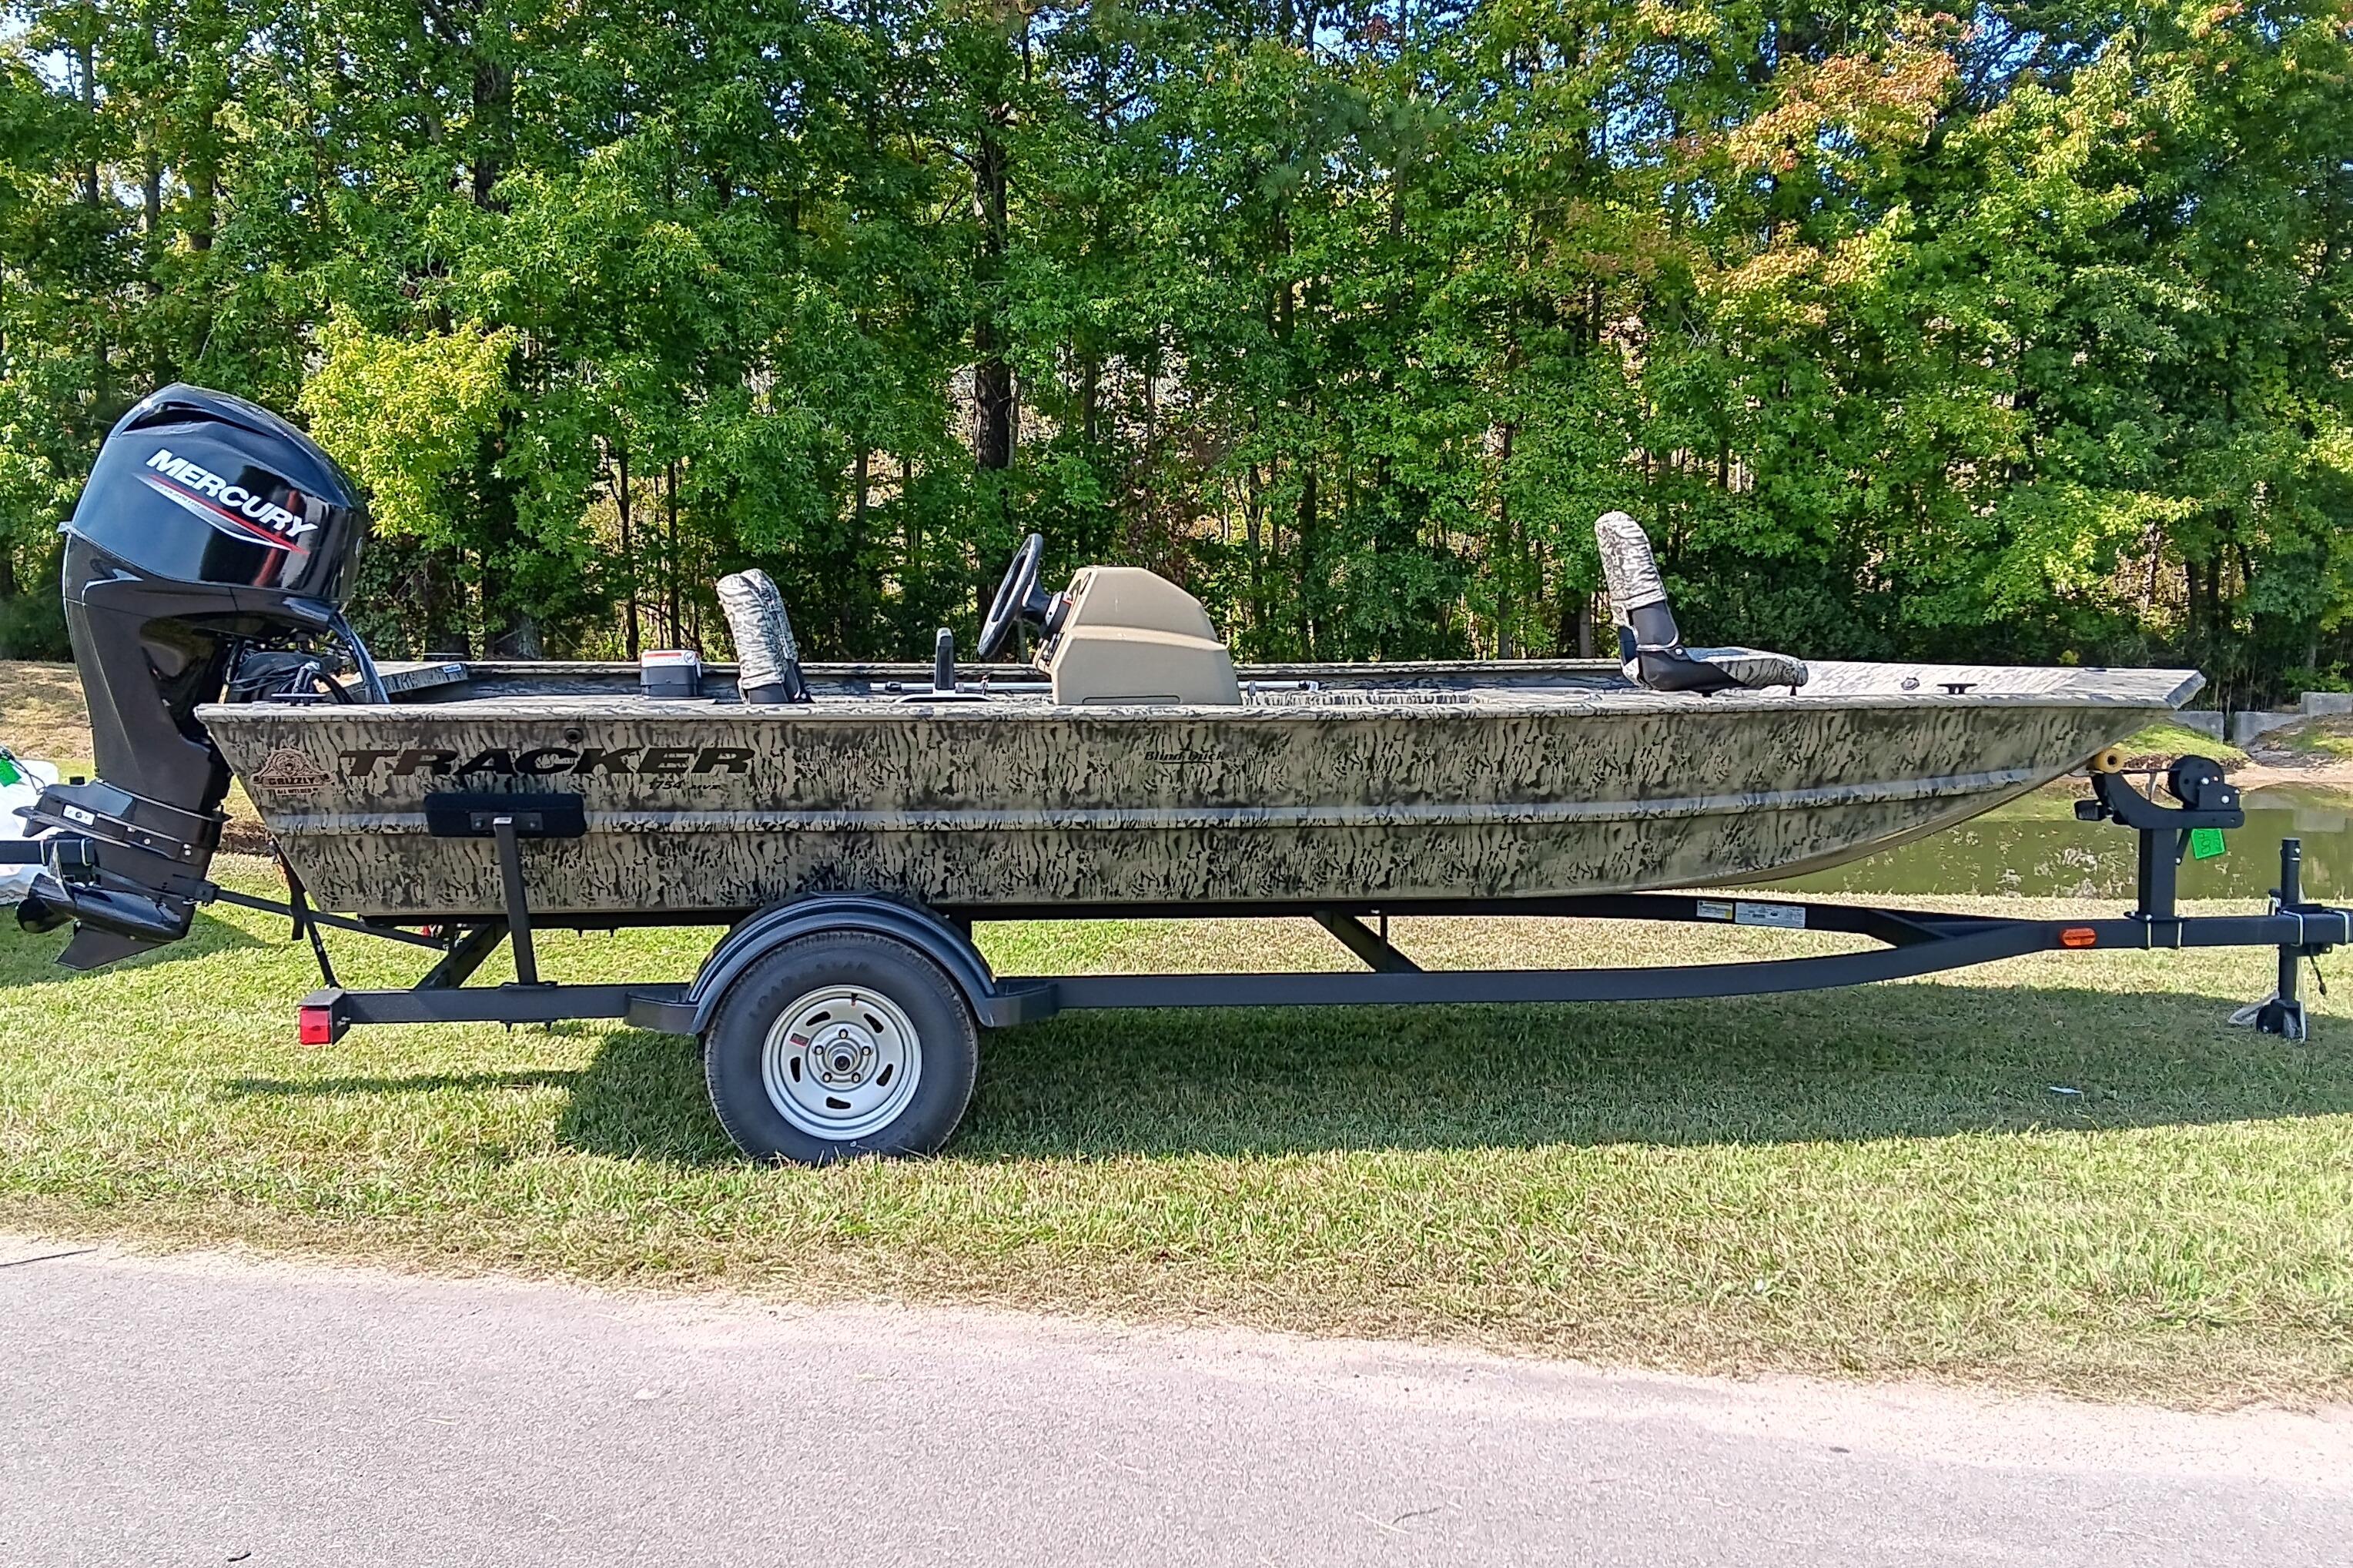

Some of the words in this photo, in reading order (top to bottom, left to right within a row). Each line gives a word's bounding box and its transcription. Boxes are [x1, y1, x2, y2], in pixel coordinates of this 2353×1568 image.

[146, 448, 319, 537] MERCURY
[337, 747, 756, 776] TRACKER
[1144, 751, 1184, 761] Blind
[1188, 751, 1224, 761] Duck
[269, 777, 315, 785] GRIZZLY
[649, 779, 685, 790] 1754
